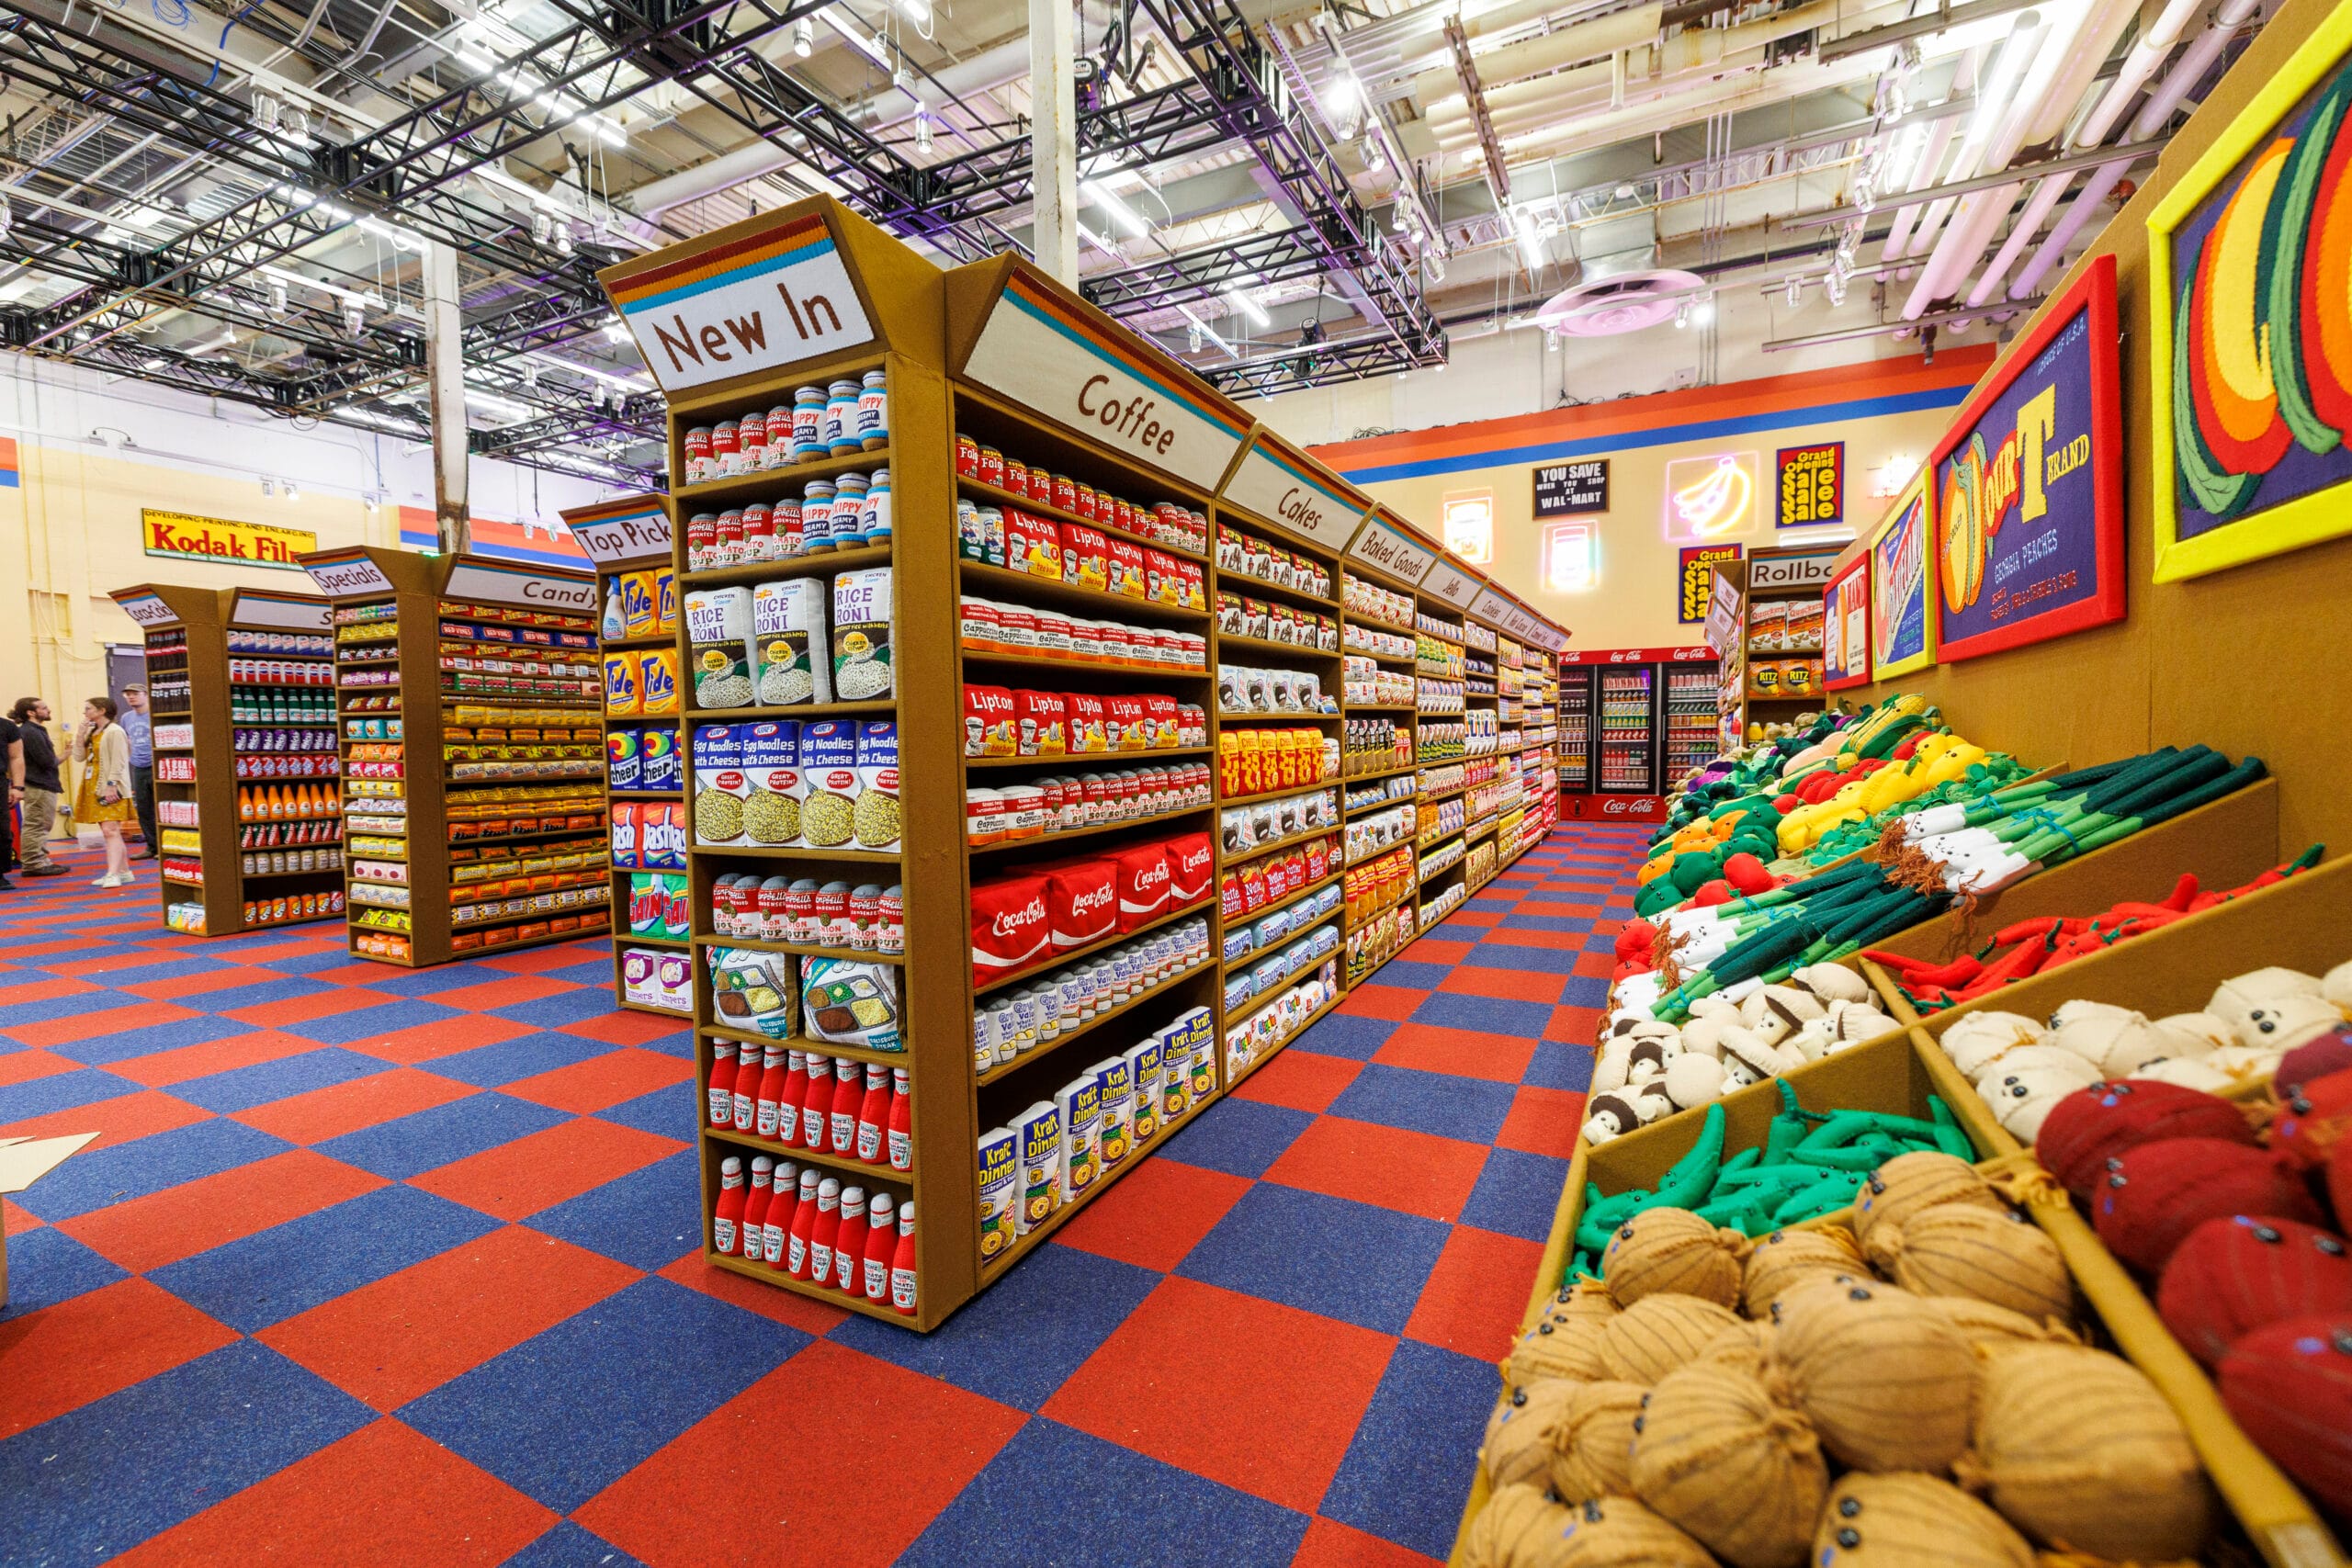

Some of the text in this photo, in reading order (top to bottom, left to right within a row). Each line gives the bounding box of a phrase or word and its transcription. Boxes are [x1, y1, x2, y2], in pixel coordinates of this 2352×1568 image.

[651, 282, 842, 373] New In
[1078, 374, 1175, 455] Coffee
[1797, 446, 1835, 463] Grand
[2046, 434, 2090, 486] BRAND
[1541, 462, 1601, 482] YOU SAVE
[1784, 457, 1835, 473] Opening
[1536, 476, 1605, 491] WHEN YOU SHOP
[1278, 488, 1323, 531] Cakes
[1542, 491, 1601, 509] WAL-MART
[145, 510, 313, 538] DEVELOPING PRINTING AND ENLARGING
[1013, 512, 1055, 537] Lipton
[152, 523, 247, 558] Kodak
[577, 529, 624, 557] Top
[1073, 528, 1106, 549] Lipton
[1360, 530, 1424, 578] Baked Goods
[1700, 550, 1734, 563] Grand
[2022, 528, 2058, 570] PEACHES
[313, 564, 382, 593] Specials
[523, 581, 597, 608] Candy
[624, 579, 652, 626] Tide
[837, 587, 873, 606] RICE
[125, 602, 174, 622] Coca-Cola
[756, 597, 789, 616] RICE
[837, 606, 872, 625] RONI
[692, 608, 724, 626] RICE
[756, 615, 788, 634] RONI
[693, 626, 726, 641] RONI
[1611, 649, 1642, 662] Coca-Cola
[1674, 648, 1706, 660] Coca-Cola
[605, 660, 635, 704] Tide
[641, 657, 674, 702] Tide
[1759, 671, 1778, 681] RITZ
[1789, 670, 1808, 681] RITZ
[971, 692, 1013, 711] Lipton
[1029, 695, 1064, 716] Lipton
[1148, 698, 1175, 715] Lipton
[695, 739, 741, 753] Egg Noodles
[743, 738, 795, 752] Egg Noodles
[816, 738, 854, 750] Noodles
[870, 736, 898, 749] Noodle
[708, 755, 741, 765] Cheese
[758, 754, 793, 765] Cheese
[816, 754, 853, 765] Cheese
[859, 753, 898, 764] ith Chees
[1603, 798, 1656, 814] Coca-Cola
[1135, 859, 1170, 892] Coca-Cola
[630, 892, 663, 923] GAIN
[1072, 882, 1114, 917] Coca-Cola
[992, 896, 1046, 937] Coca-Cola
[1193, 1012, 1210, 1031] Kraft
[1172, 1029, 1189, 1048] Kraft
[1141, 1050, 1159, 1068] Kraft
[1108, 1066, 1127, 1087] Kraft
[1078, 1086, 1097, 1107] Kraft
[1102, 1082, 1130, 1101] Dinner
[1073, 1102, 1100, 1125] Dinner
[1033, 1113, 1059, 1137] Kraft
[986, 1142, 1011, 1166] Kraft
[979, 1158, 1016, 1185] Dinner
